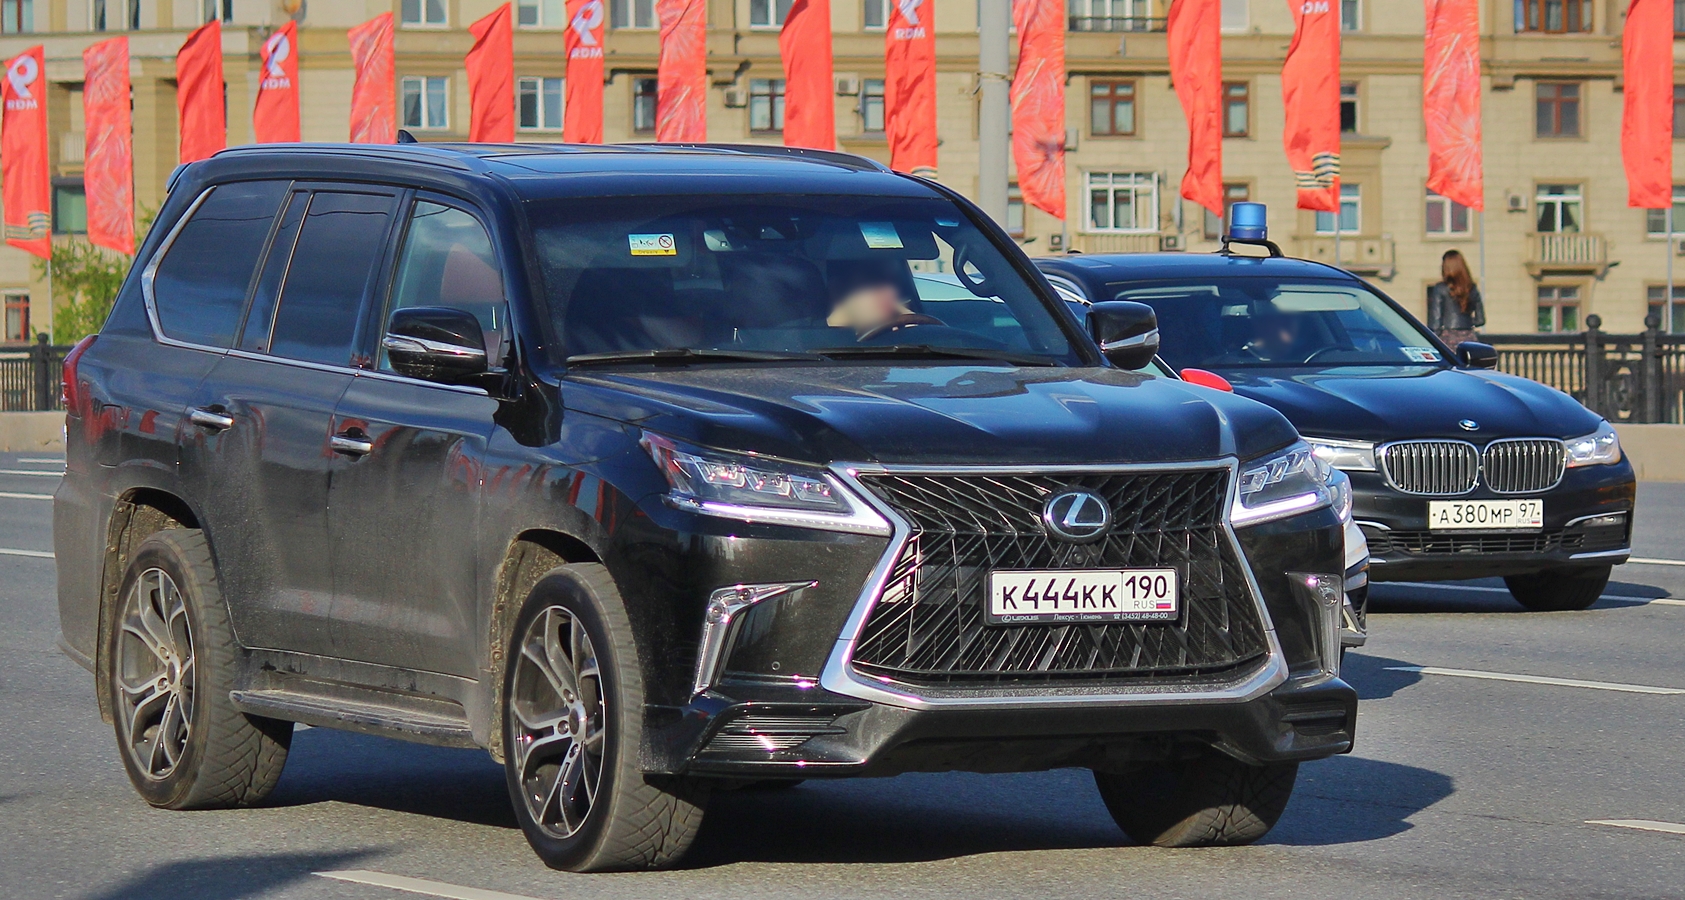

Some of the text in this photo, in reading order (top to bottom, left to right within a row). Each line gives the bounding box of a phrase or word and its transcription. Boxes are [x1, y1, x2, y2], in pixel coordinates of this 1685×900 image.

[1300, 1, 1329, 14] DM
[895, 28, 926, 40] RDM
[571, 47, 603, 58] RDM
[6, 99, 38, 110] RDM
[1519, 503, 1536, 518] 97
[1002, 575, 1167, 610] К444КК 190
[1133, 600, 1155, 609] RUS
